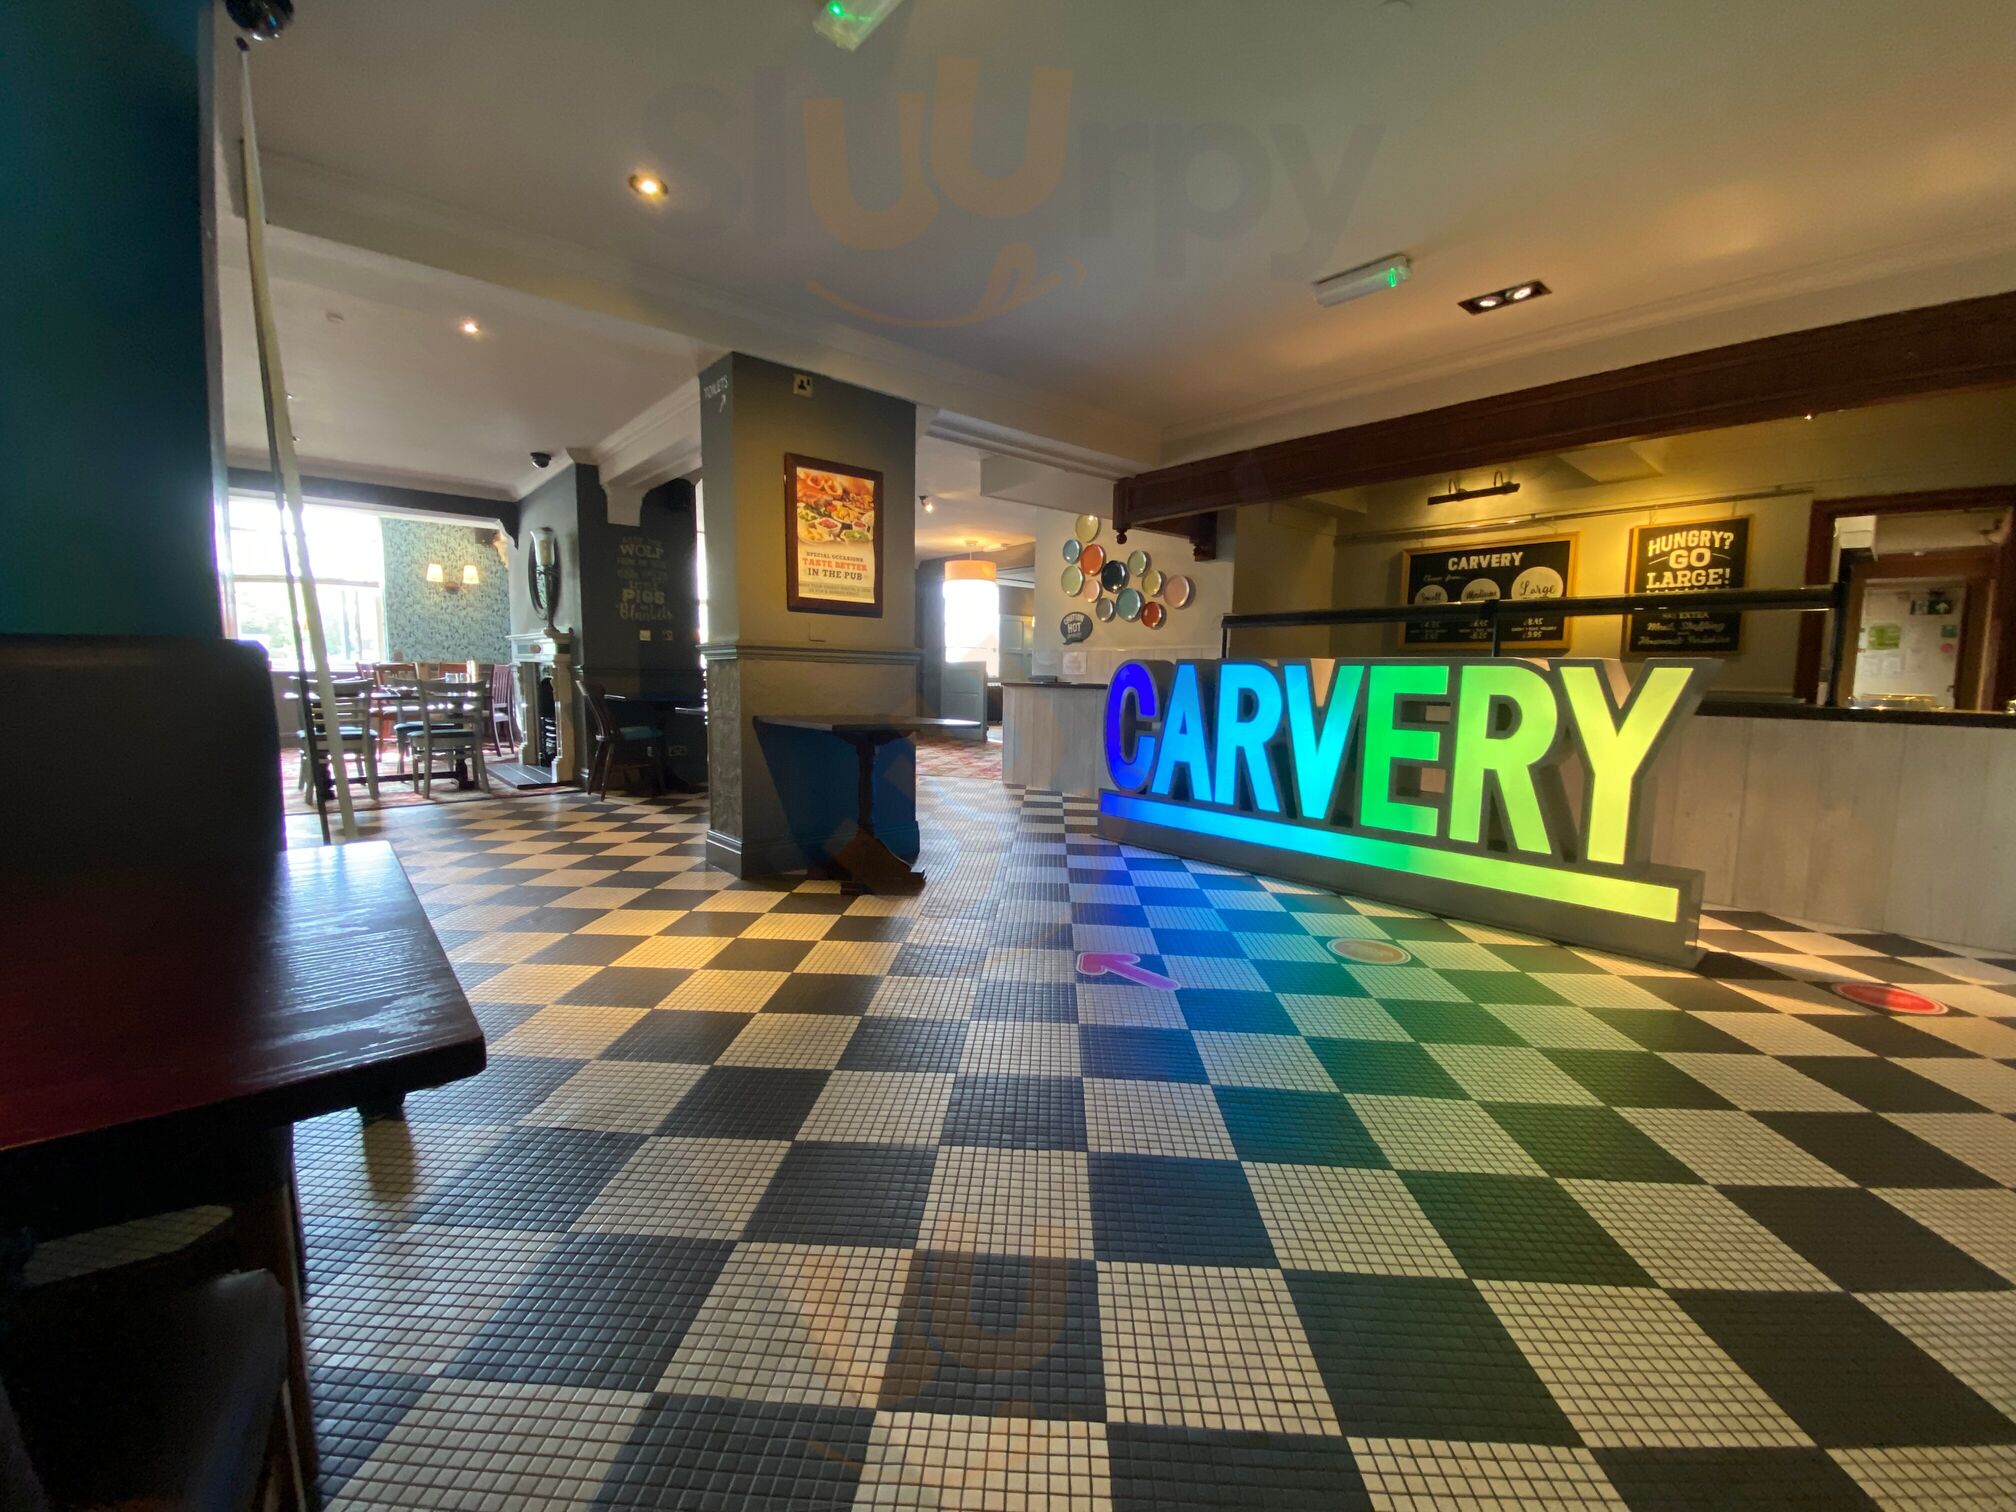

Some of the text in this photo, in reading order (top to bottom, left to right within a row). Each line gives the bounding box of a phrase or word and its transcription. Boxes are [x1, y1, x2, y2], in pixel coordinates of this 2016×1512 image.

[1648, 530, 1735, 557] HUNGRY?
[802, 557, 868, 572] TASTE BETTER
[1447, 551, 1524, 571] CARVERY
[1668, 547, 1712, 569] GO
[807, 567, 863, 581] IN THE PUB
[1645, 567, 1731, 589] LARGE!
[622, 588, 665, 606] PIGS
[1519, 580, 1556, 596] Large
[1067, 622, 1082, 634] HOT
[1104, 661, 1695, 866] CARVERY
